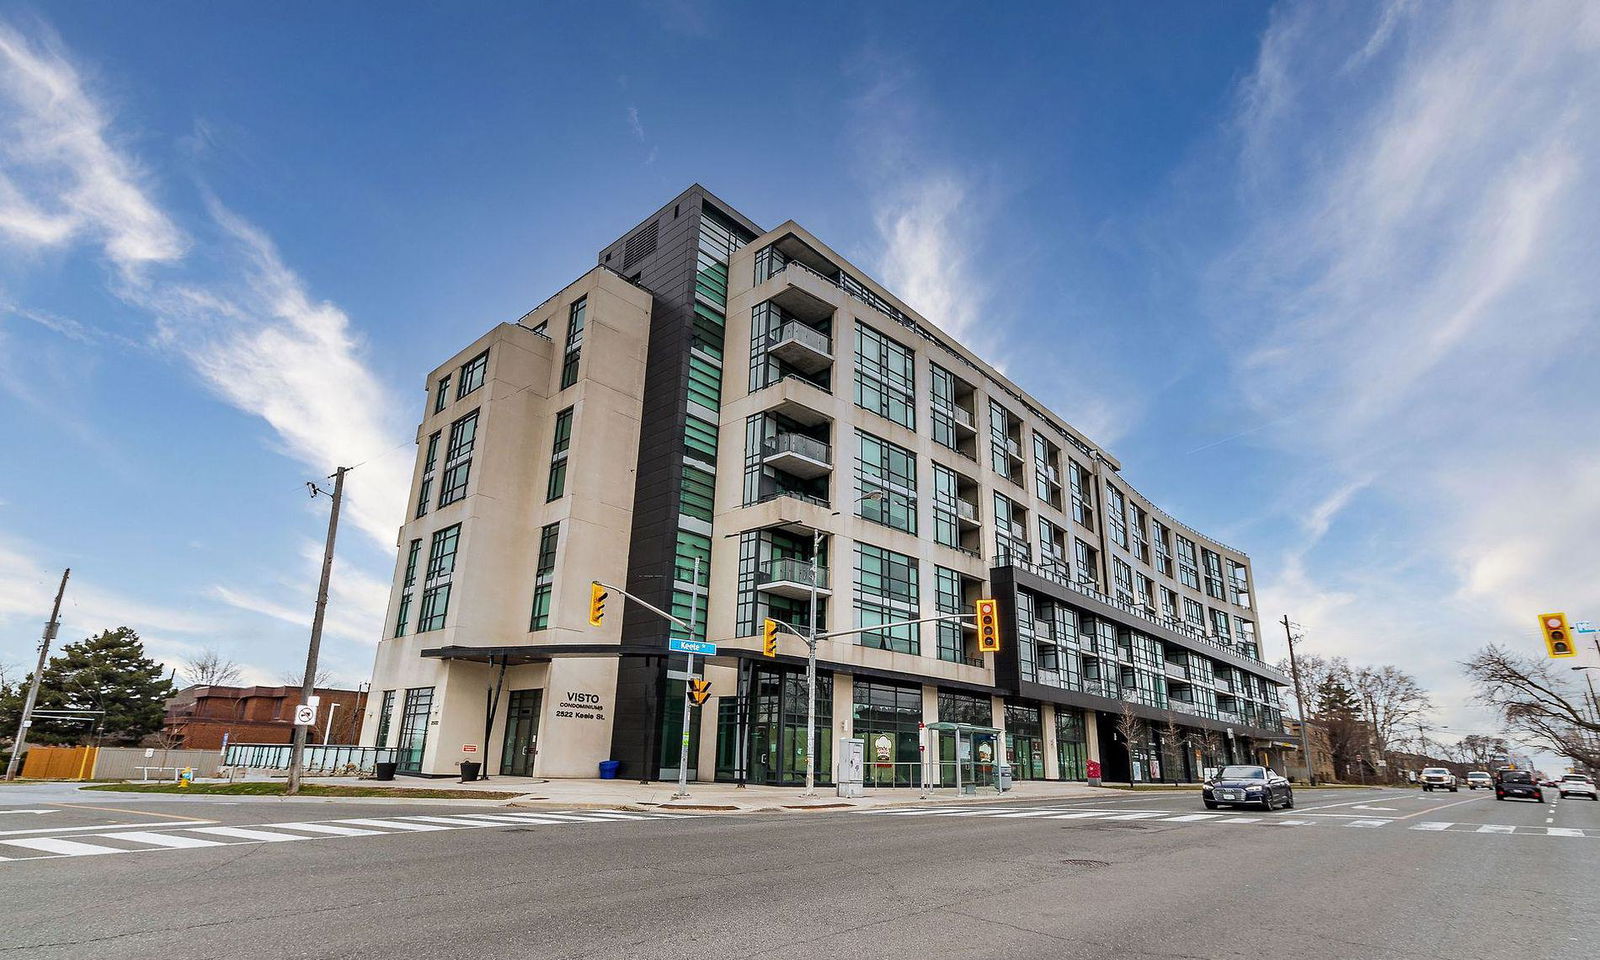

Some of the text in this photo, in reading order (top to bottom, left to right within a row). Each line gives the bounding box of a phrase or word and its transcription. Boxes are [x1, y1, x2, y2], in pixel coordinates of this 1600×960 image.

[681, 641, 699, 651] Keele
[567, 692, 599, 703] VISTO
[560, 702, 603, 711] CONDOMINIUMS
[556, 710, 573, 718] 2522
[575, 712, 594, 720] Keele
